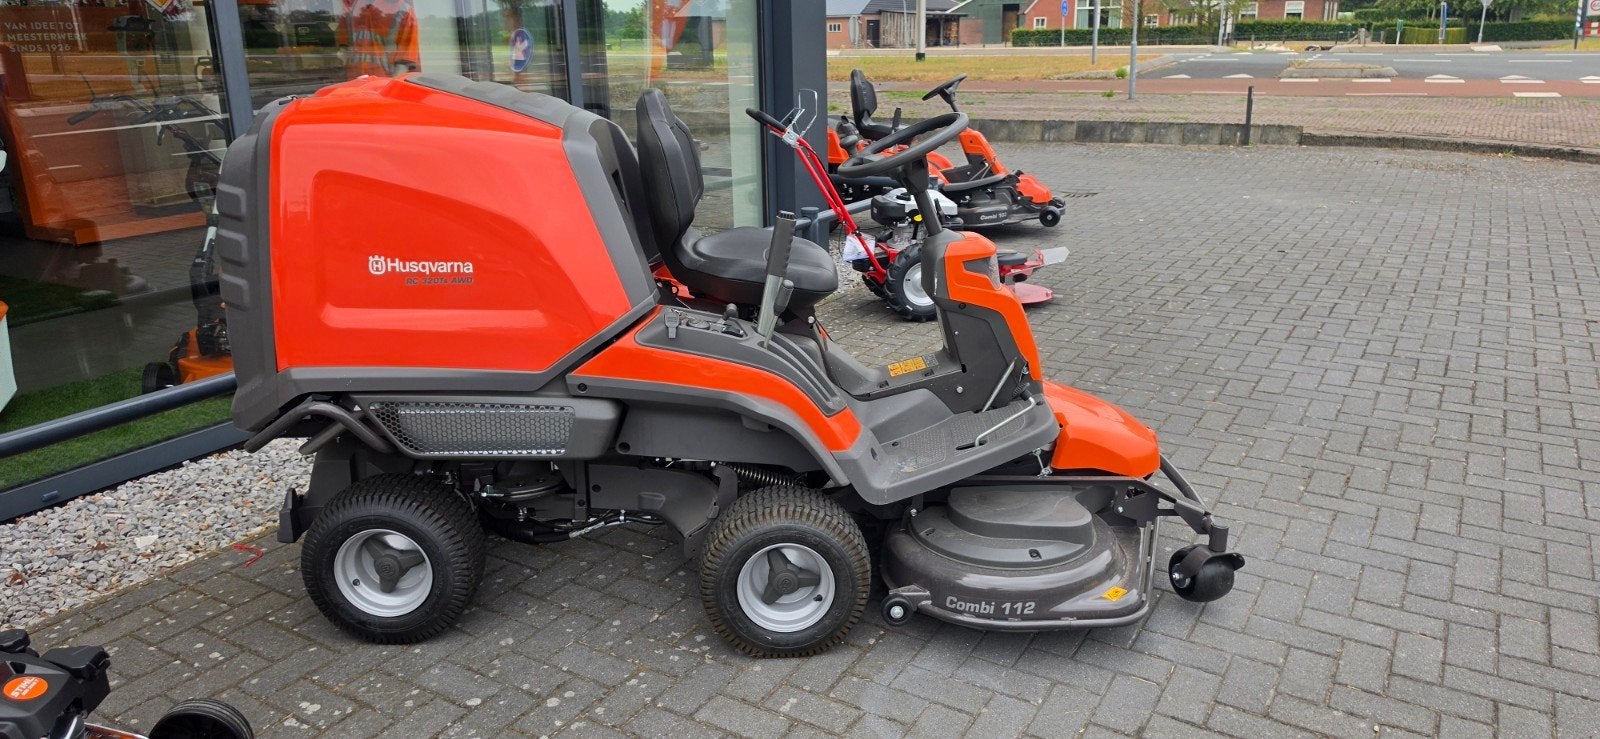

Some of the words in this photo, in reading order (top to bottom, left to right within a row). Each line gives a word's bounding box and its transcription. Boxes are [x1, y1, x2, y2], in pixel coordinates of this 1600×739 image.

[4, 22, 27, 30] VAN
[31, 22, 56, 30] IDEE
[7, 33, 88, 41] MEESTERWERK
[9, 44, 43, 53] SINDS
[47, 44, 71, 52] 1926
[387, 258, 474, 275] Husqvarna
[451, 276, 473, 284] AWD
[945, 596, 995, 614] Combi
[1001, 601, 1036, 615] 112
[11, 676, 35, 698] STIHL
